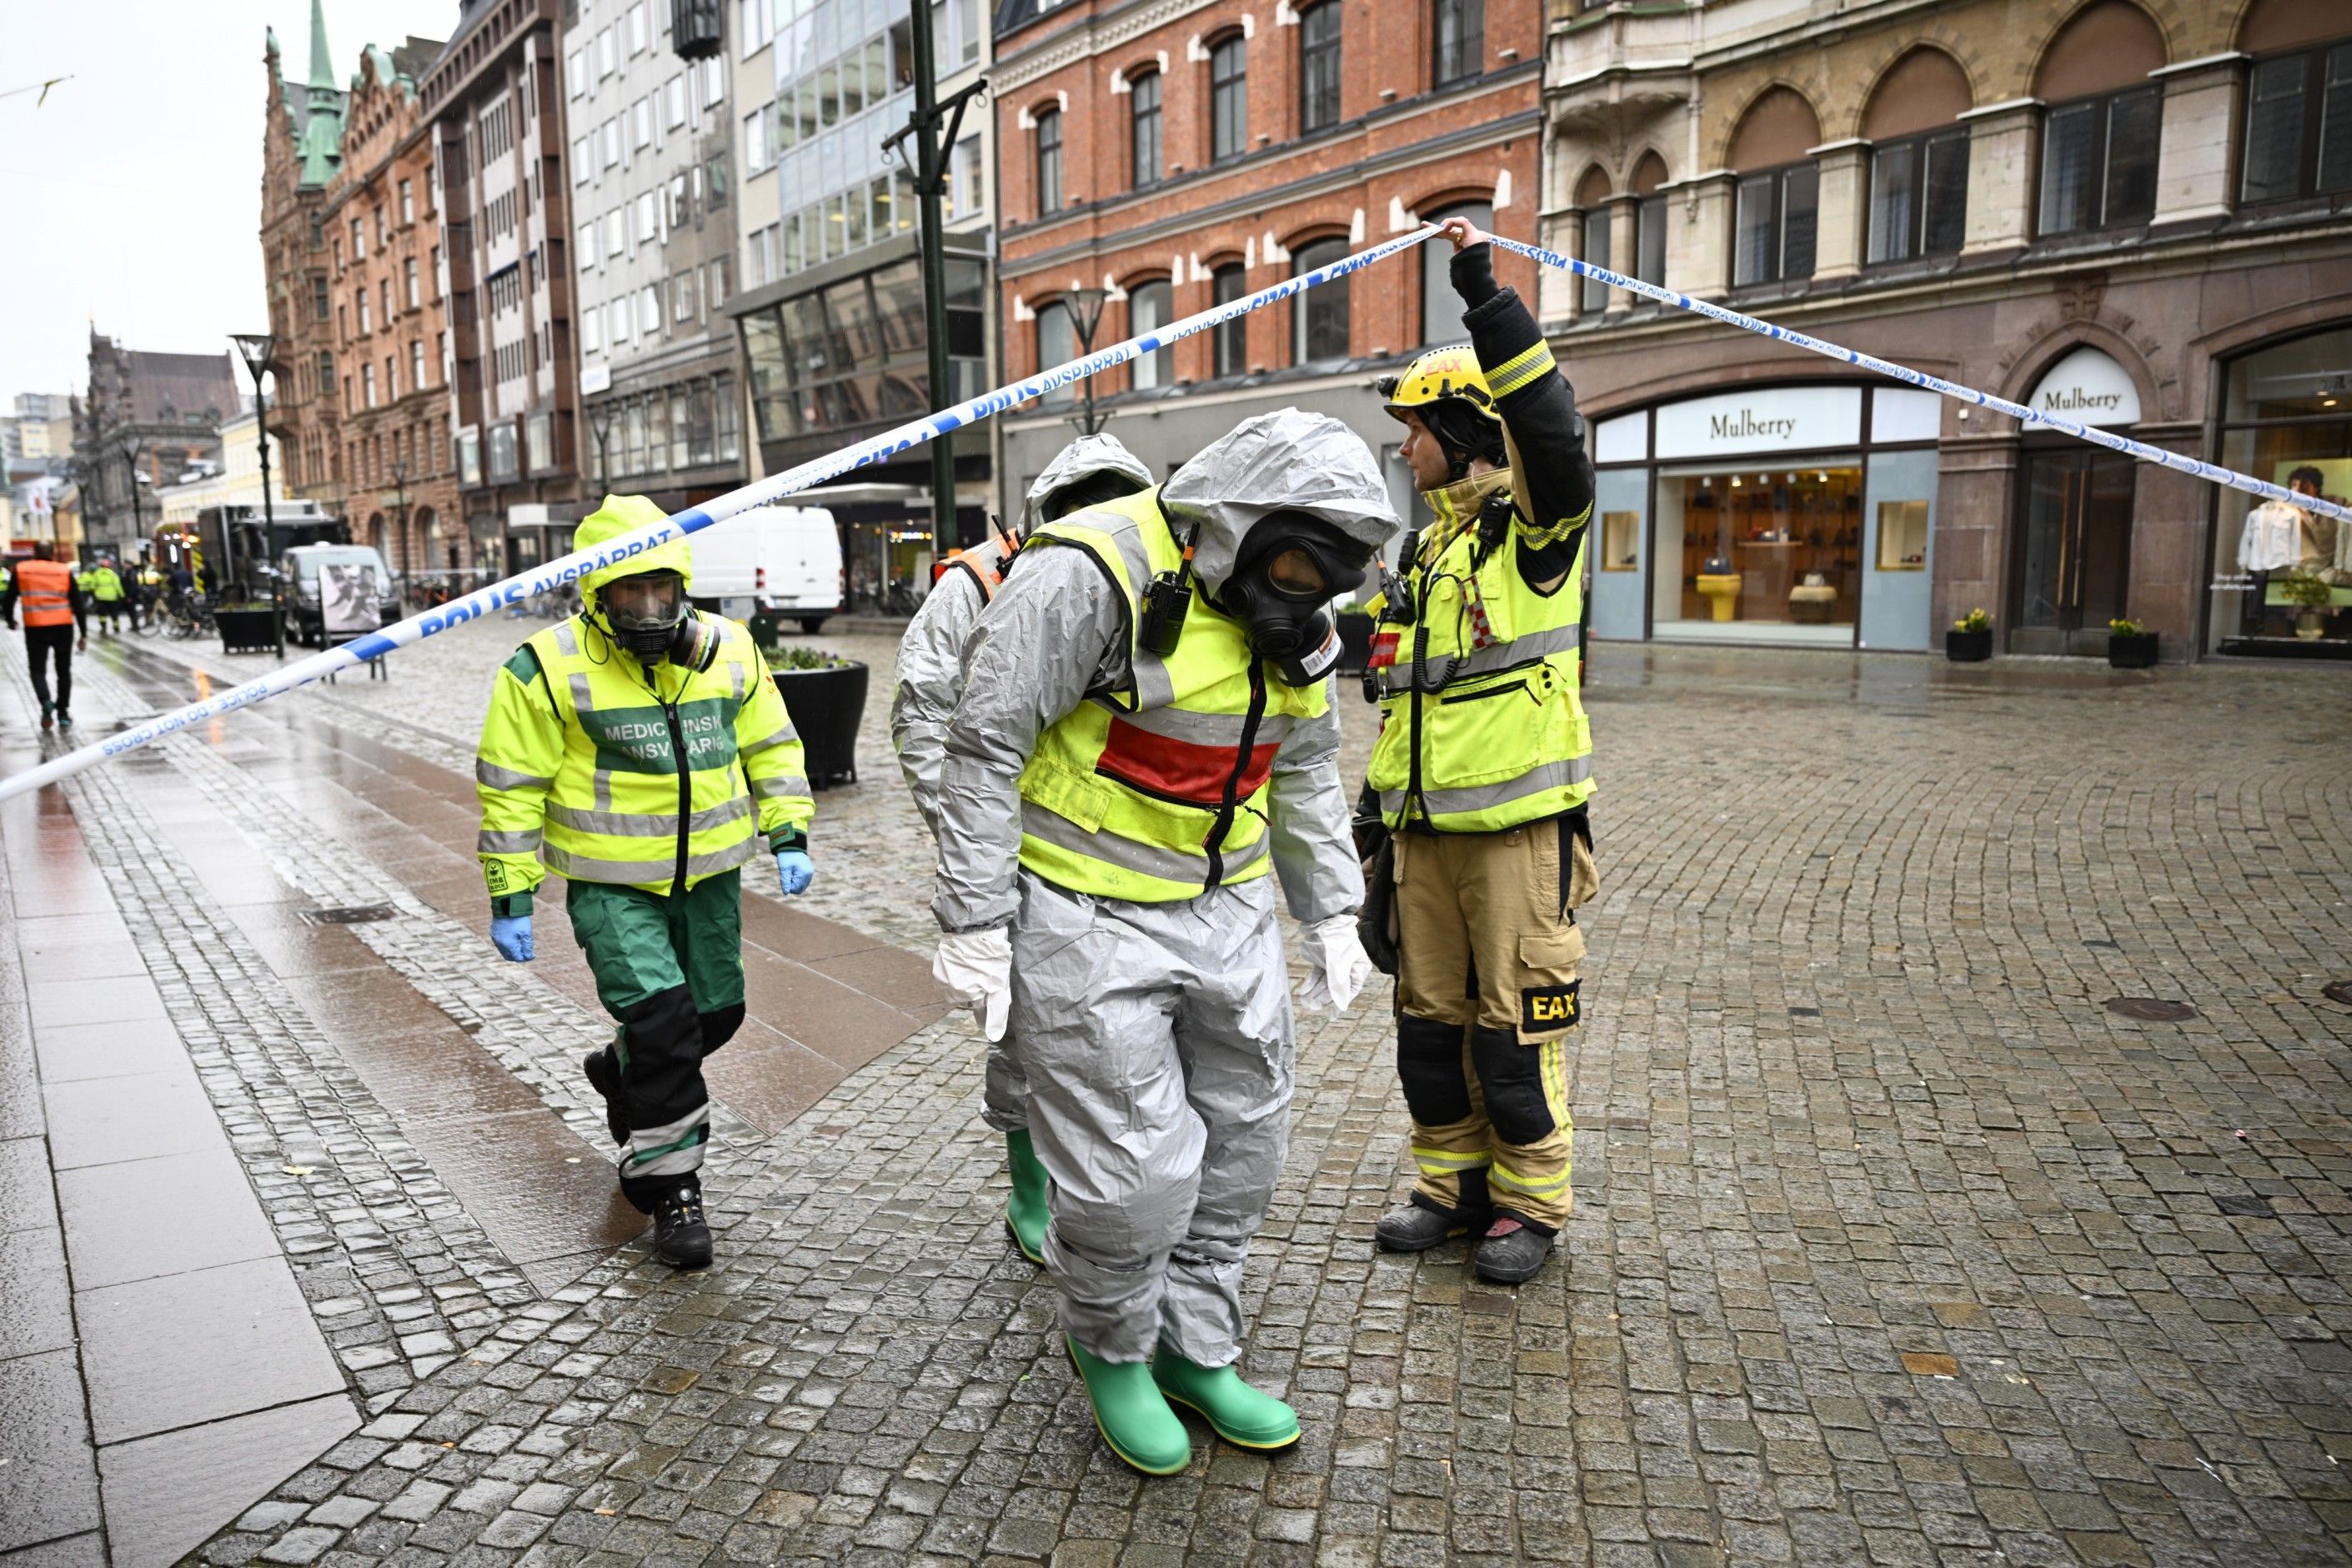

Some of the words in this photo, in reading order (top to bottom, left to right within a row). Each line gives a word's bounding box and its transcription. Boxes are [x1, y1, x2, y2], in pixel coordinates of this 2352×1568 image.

[1426, 358, 1462, 376] EAX
[2044, 387, 2122, 410] Mulberry
[1710, 408, 1796, 439] Mulberry
[218, 683, 268, 710] POLICE
[158, 715, 186, 735] NOT
[187, 706, 209, 722] DO
[102, 728, 153, 756] CROSS
[1532, 991, 1575, 1020] EAX
